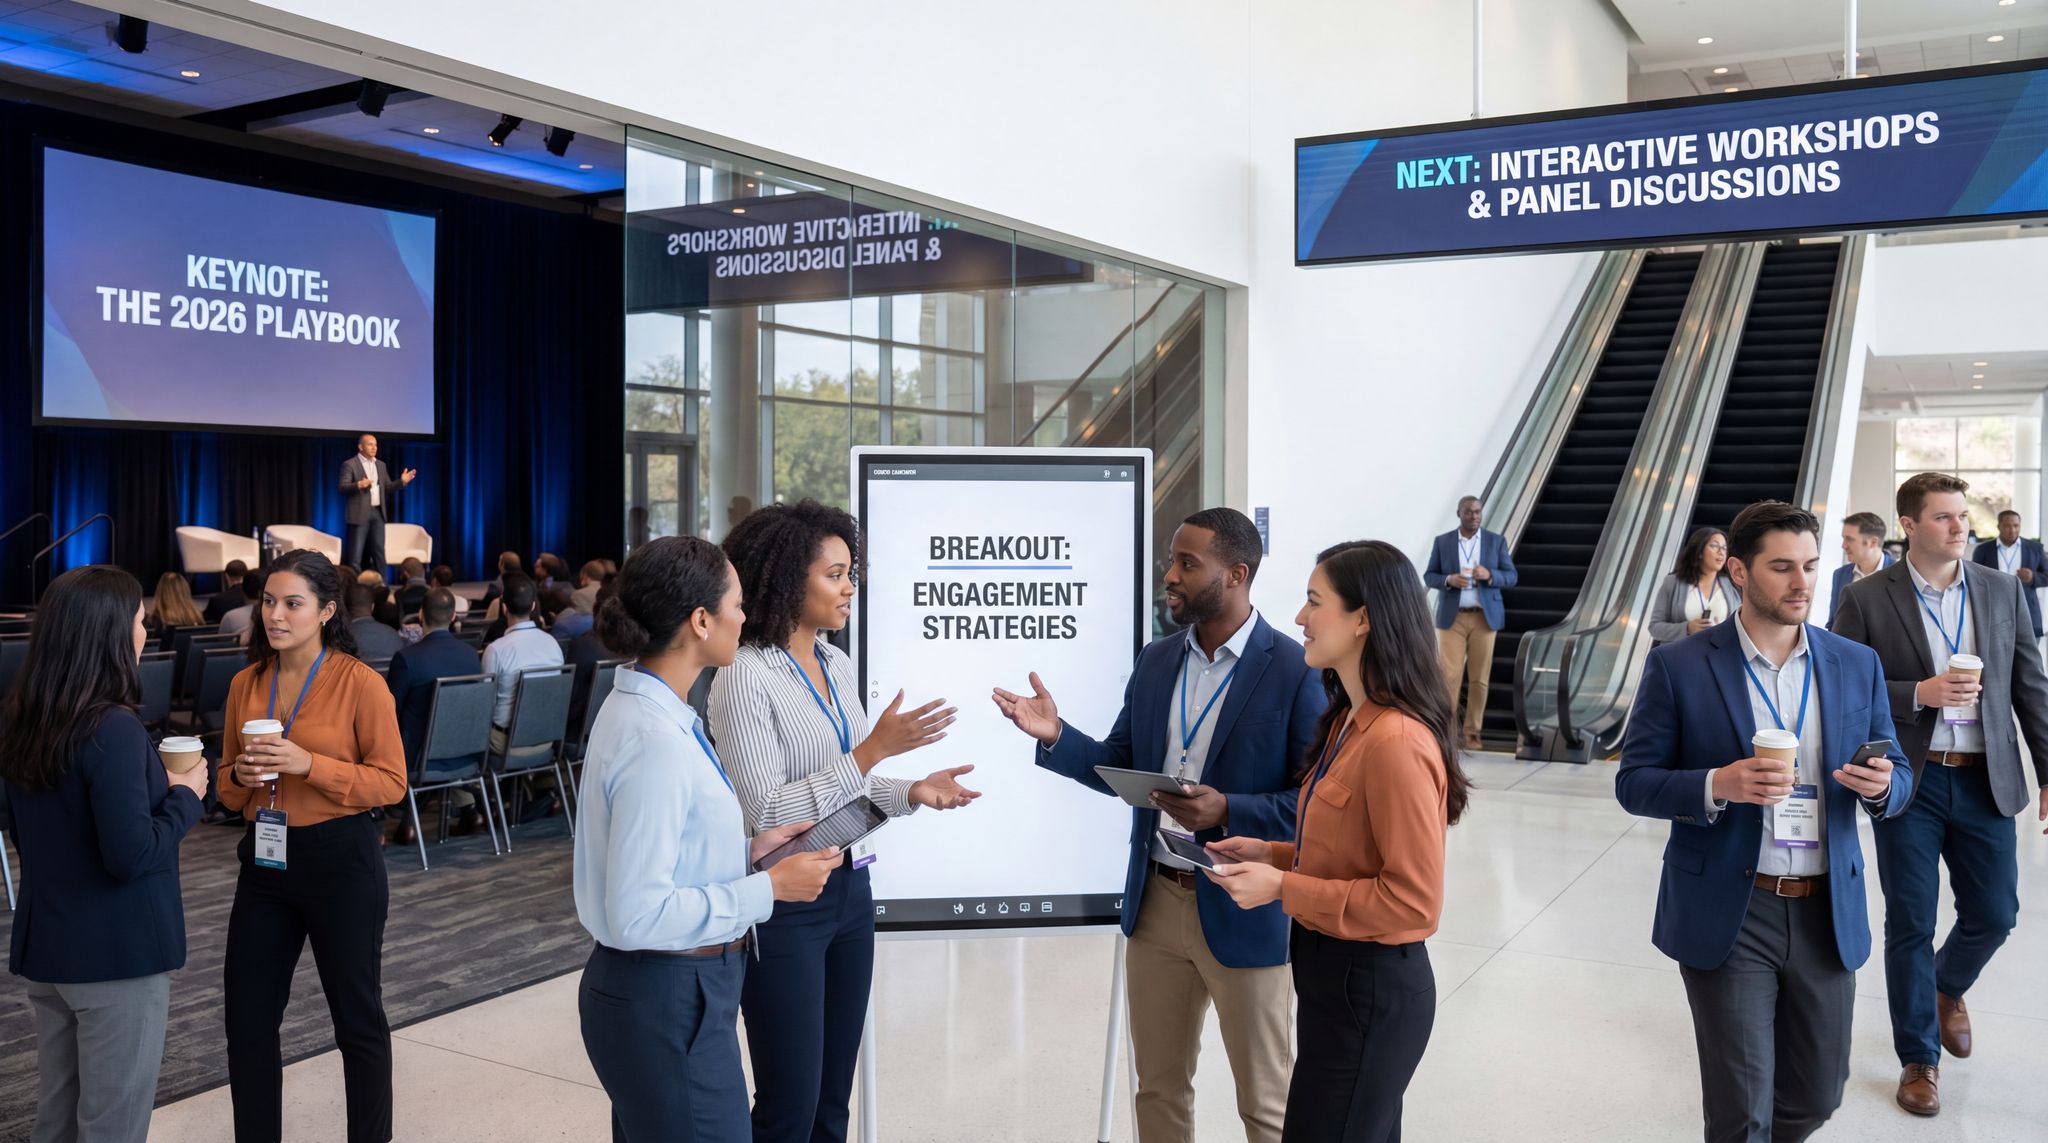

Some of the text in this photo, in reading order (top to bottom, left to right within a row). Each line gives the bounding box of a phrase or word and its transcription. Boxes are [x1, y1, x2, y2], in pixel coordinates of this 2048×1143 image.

[1396, 110, 1941, 190] NEXT: INTERACTIVE WORKSHOPS
[1467, 160, 1841, 219] & PANEL DISCUSSIONS
[186, 253, 329, 303] KEYNOTE:
[95, 285, 401, 349] THE 2026 PLAYBOOK
[929, 535, 1071, 561] BREAKOUT:
[913, 581, 1088, 607] ENGAGEMENT
[922, 614, 1077, 640] STRATEGIES
